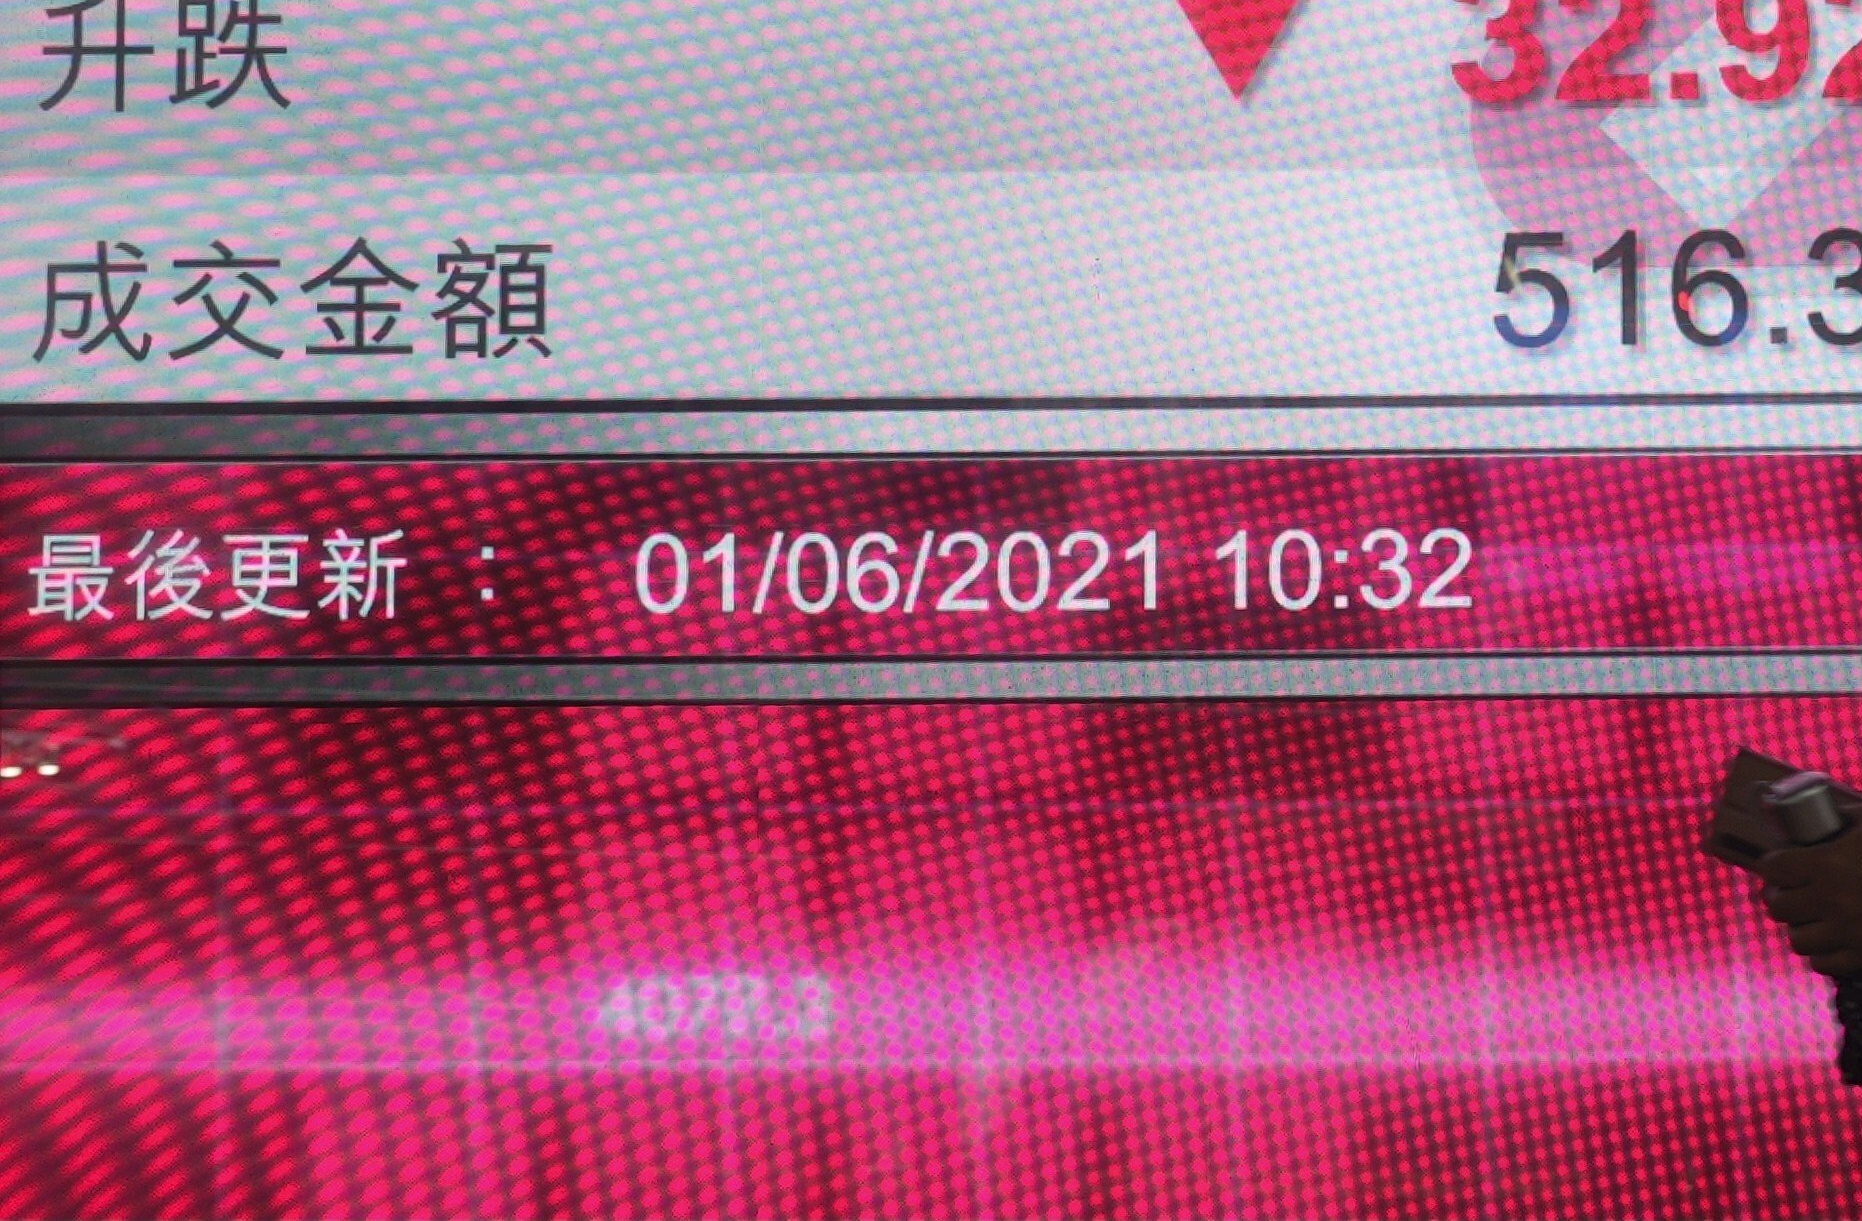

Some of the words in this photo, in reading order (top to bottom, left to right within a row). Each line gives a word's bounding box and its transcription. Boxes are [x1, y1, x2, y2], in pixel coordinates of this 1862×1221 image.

[32, 237, 553, 363] 成交金額
[635, 529, 1159, 615] 01/06/2021
[1214, 527, 1473, 612] 10:32
